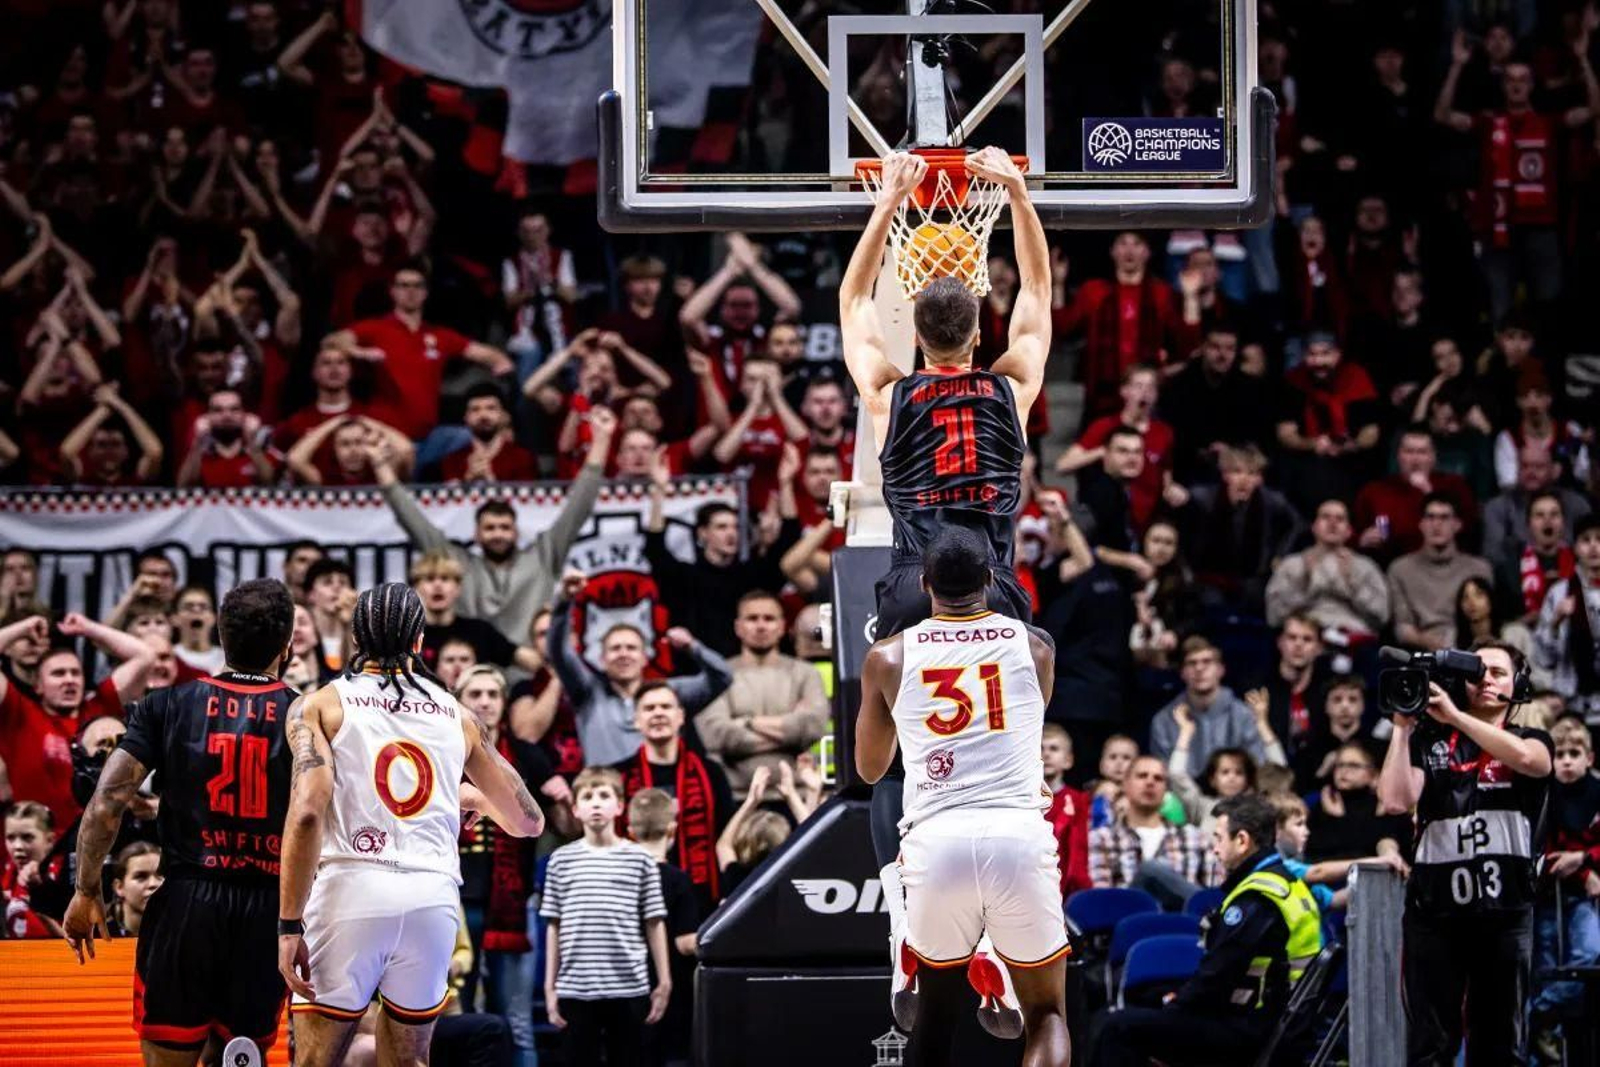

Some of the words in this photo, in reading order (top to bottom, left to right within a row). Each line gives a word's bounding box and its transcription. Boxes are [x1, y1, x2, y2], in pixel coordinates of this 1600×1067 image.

[1135, 128, 1211, 138] BASKETBALL
[1135, 139, 1221, 150] CHAMPIONS
[1135, 151, 1181, 161] LEAGUE
[932, 407, 977, 477] 21
[917, 628, 1016, 643] DELGADO
[207, 695, 277, 722] COLE
[920, 661, 1006, 736] 31
[206, 732, 269, 819] 20
[373, 739, 433, 819] 0
[791, 879, 889, 914] OI
